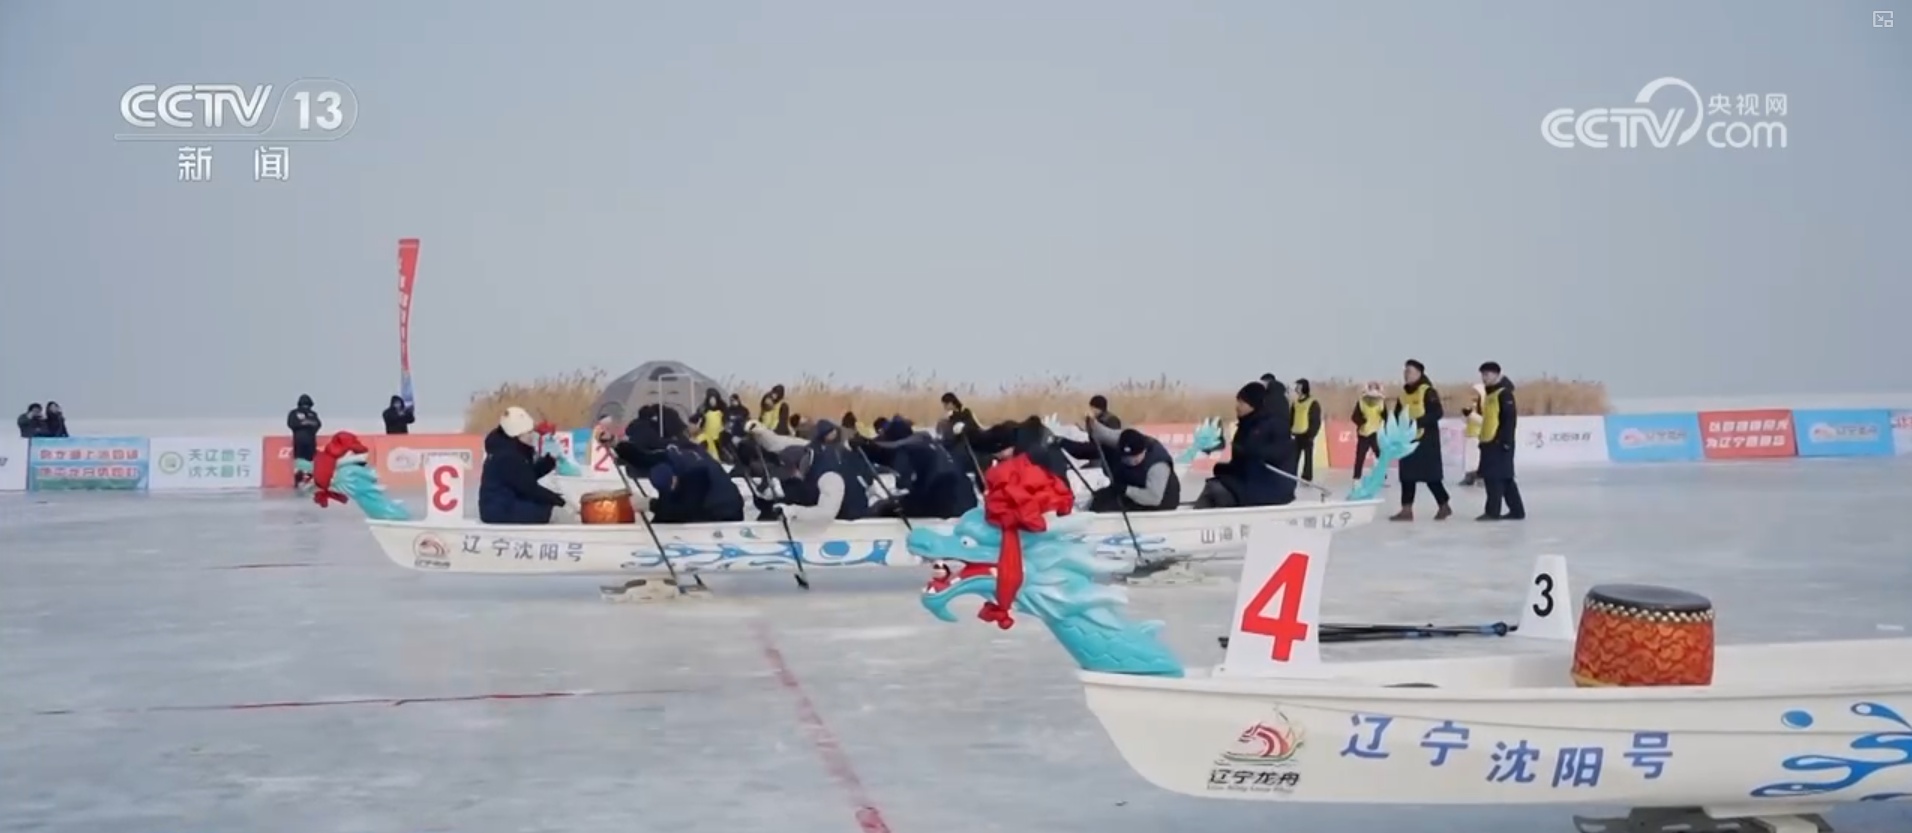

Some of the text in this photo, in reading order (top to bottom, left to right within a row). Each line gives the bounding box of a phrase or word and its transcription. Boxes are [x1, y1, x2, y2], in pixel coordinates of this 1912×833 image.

[462, 534, 584, 562] 辽宁沈阳号
[1241, 552, 1310, 662] 4
[1533, 573, 1554, 617] 3
[1340, 713, 1674, 788] 辽宁沈阳号
[1209, 769, 1300, 787] 辽宁龙舟
